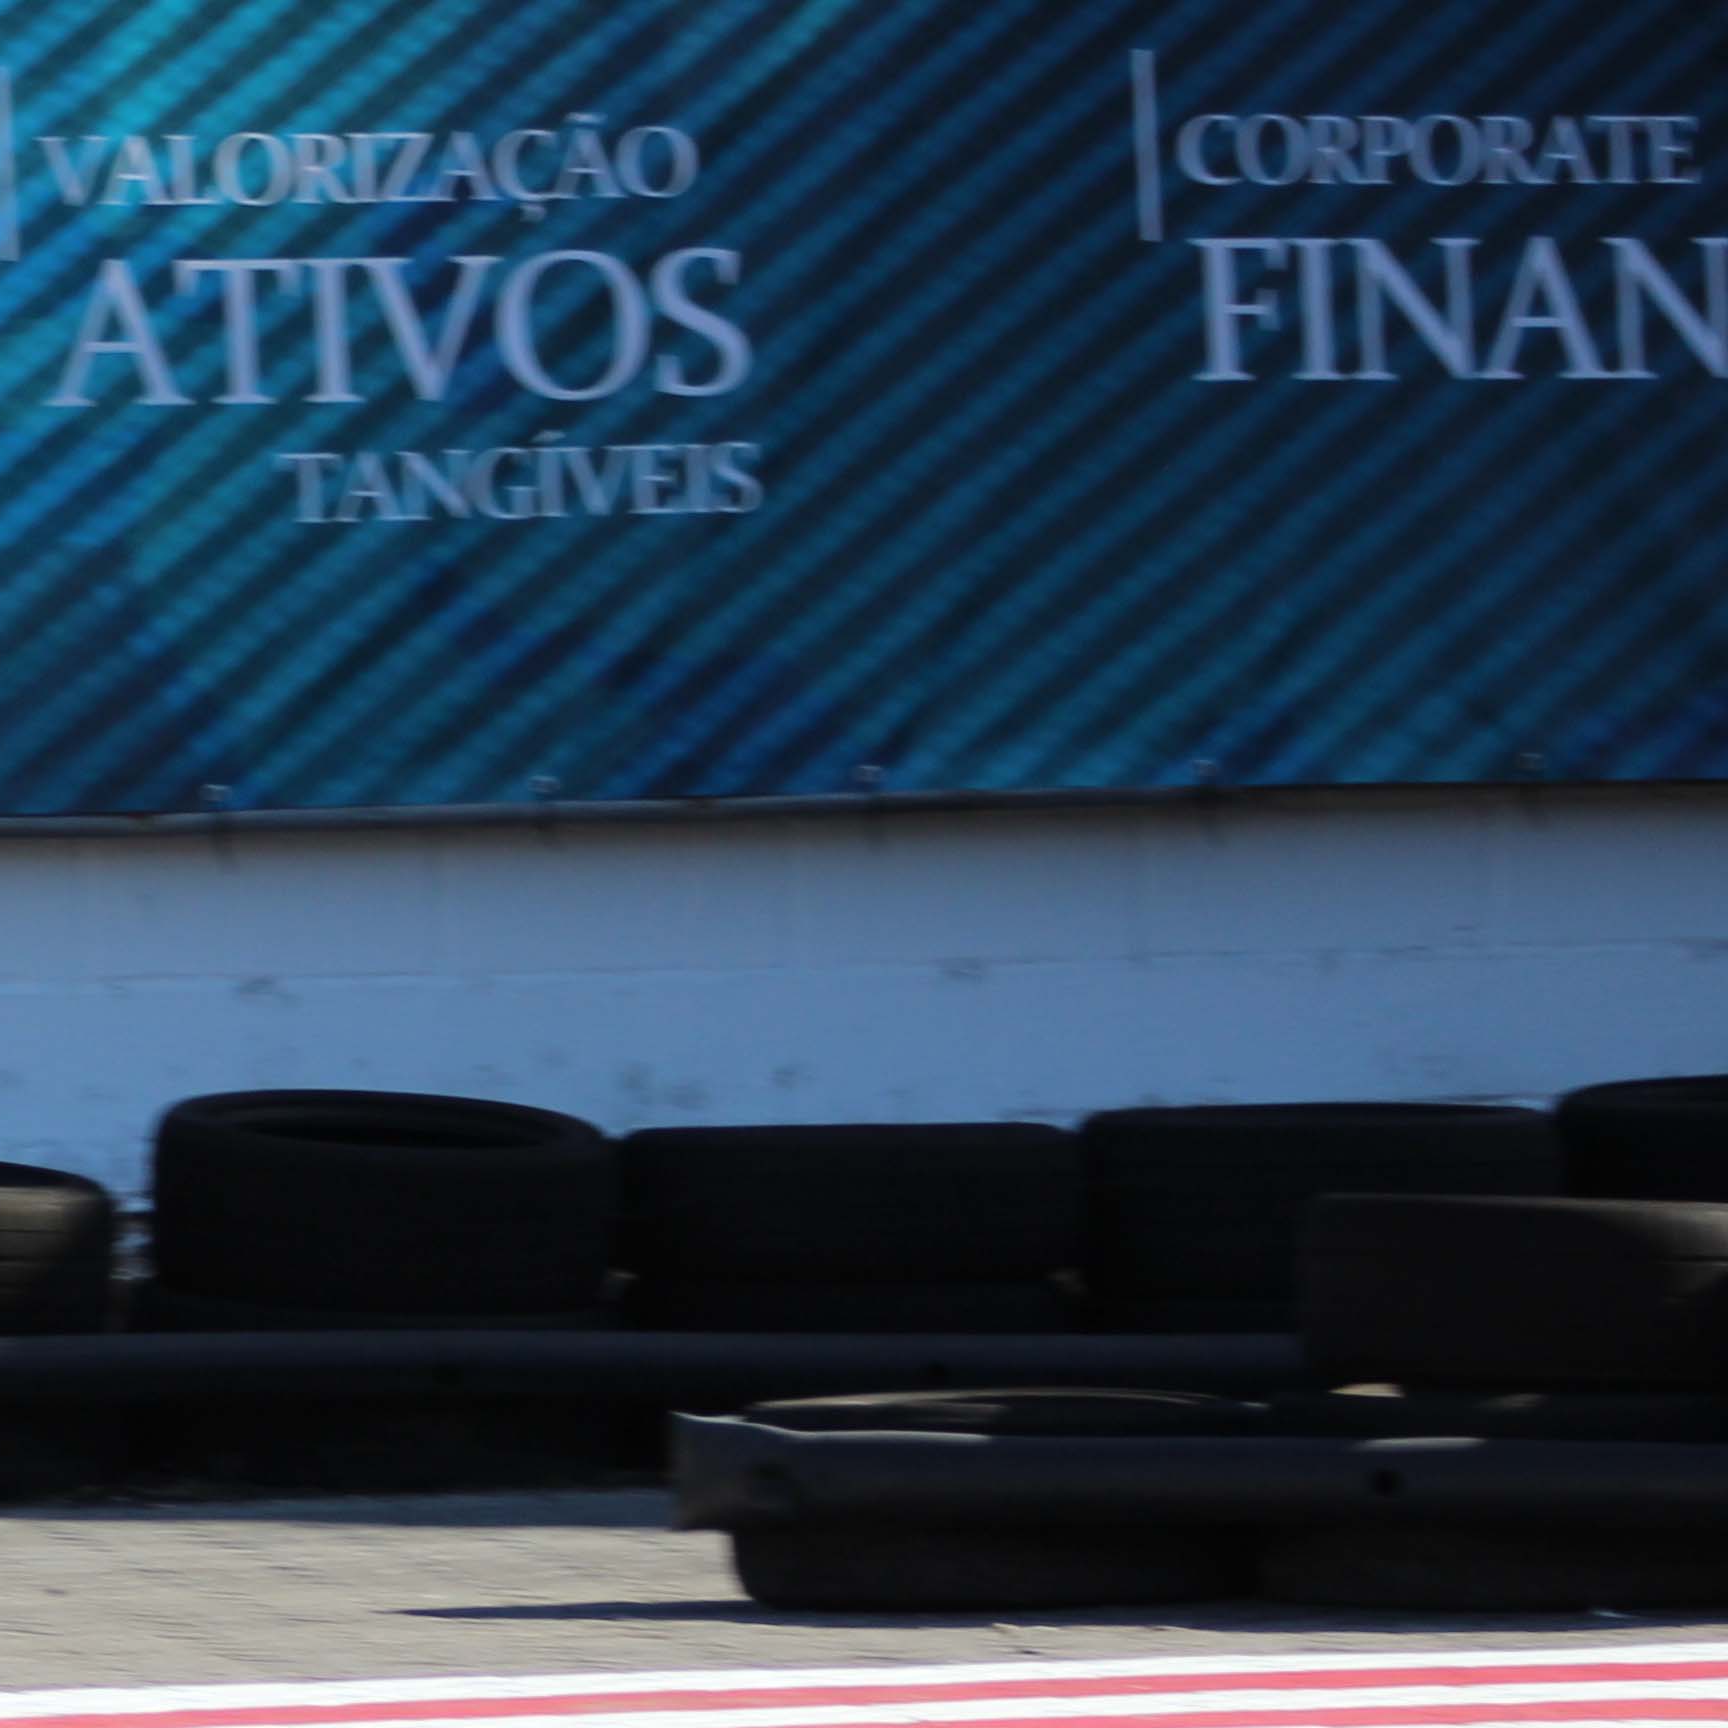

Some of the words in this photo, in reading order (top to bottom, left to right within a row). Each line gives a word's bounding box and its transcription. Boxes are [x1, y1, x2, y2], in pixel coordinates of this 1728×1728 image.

[35, 112, 700, 222] VALORIZAÇÃO
[1175, 113, 1701, 187] CORPORATE
[42, 247, 754, 407] ATIVOS
[1186, 236, 1728, 383] FINAN
[273, 430, 764, 523] TANGÍVEIS
